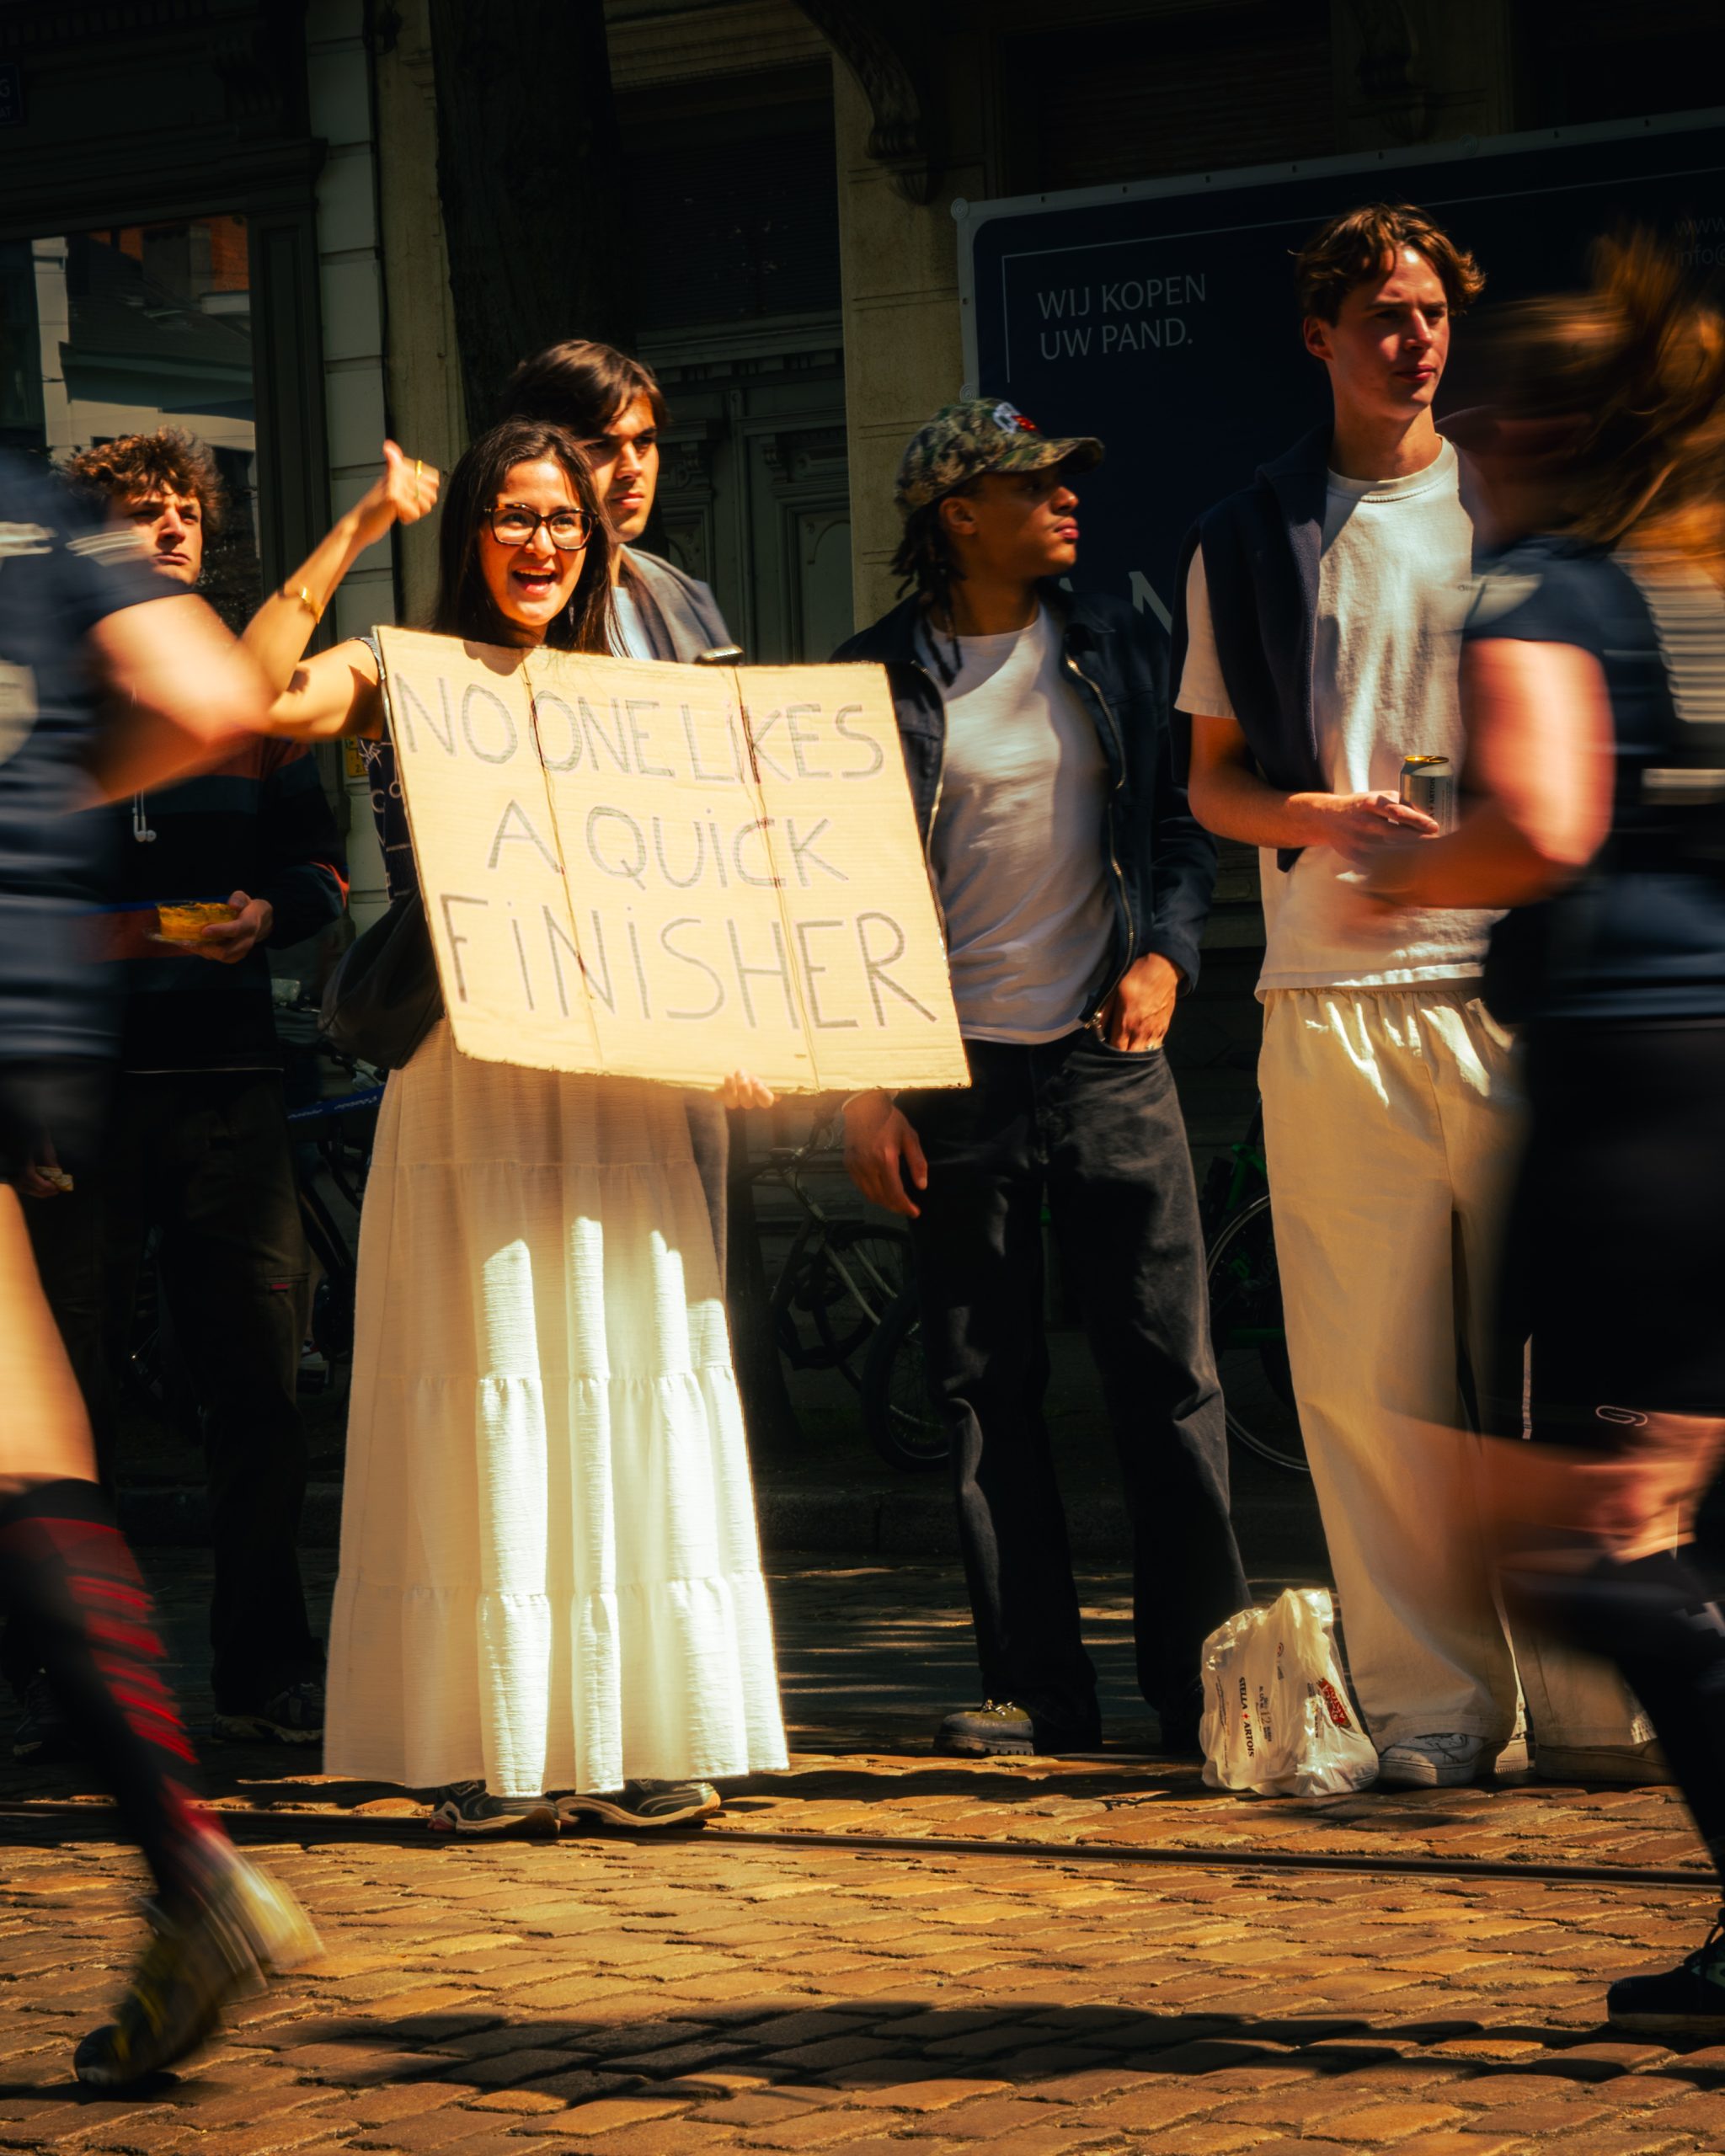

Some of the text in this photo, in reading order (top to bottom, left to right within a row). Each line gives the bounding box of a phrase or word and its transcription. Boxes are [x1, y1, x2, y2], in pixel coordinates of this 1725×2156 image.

[1037, 273, 1206, 320] WIJ KOPEN
[1040, 318, 1194, 360] UW PAND.
[394, 674, 518, 764] NO
[530, 690, 673, 777] ONE
[486, 798, 564, 876] A
[1239, 1677, 1255, 1758] STELLA ARTOIS
